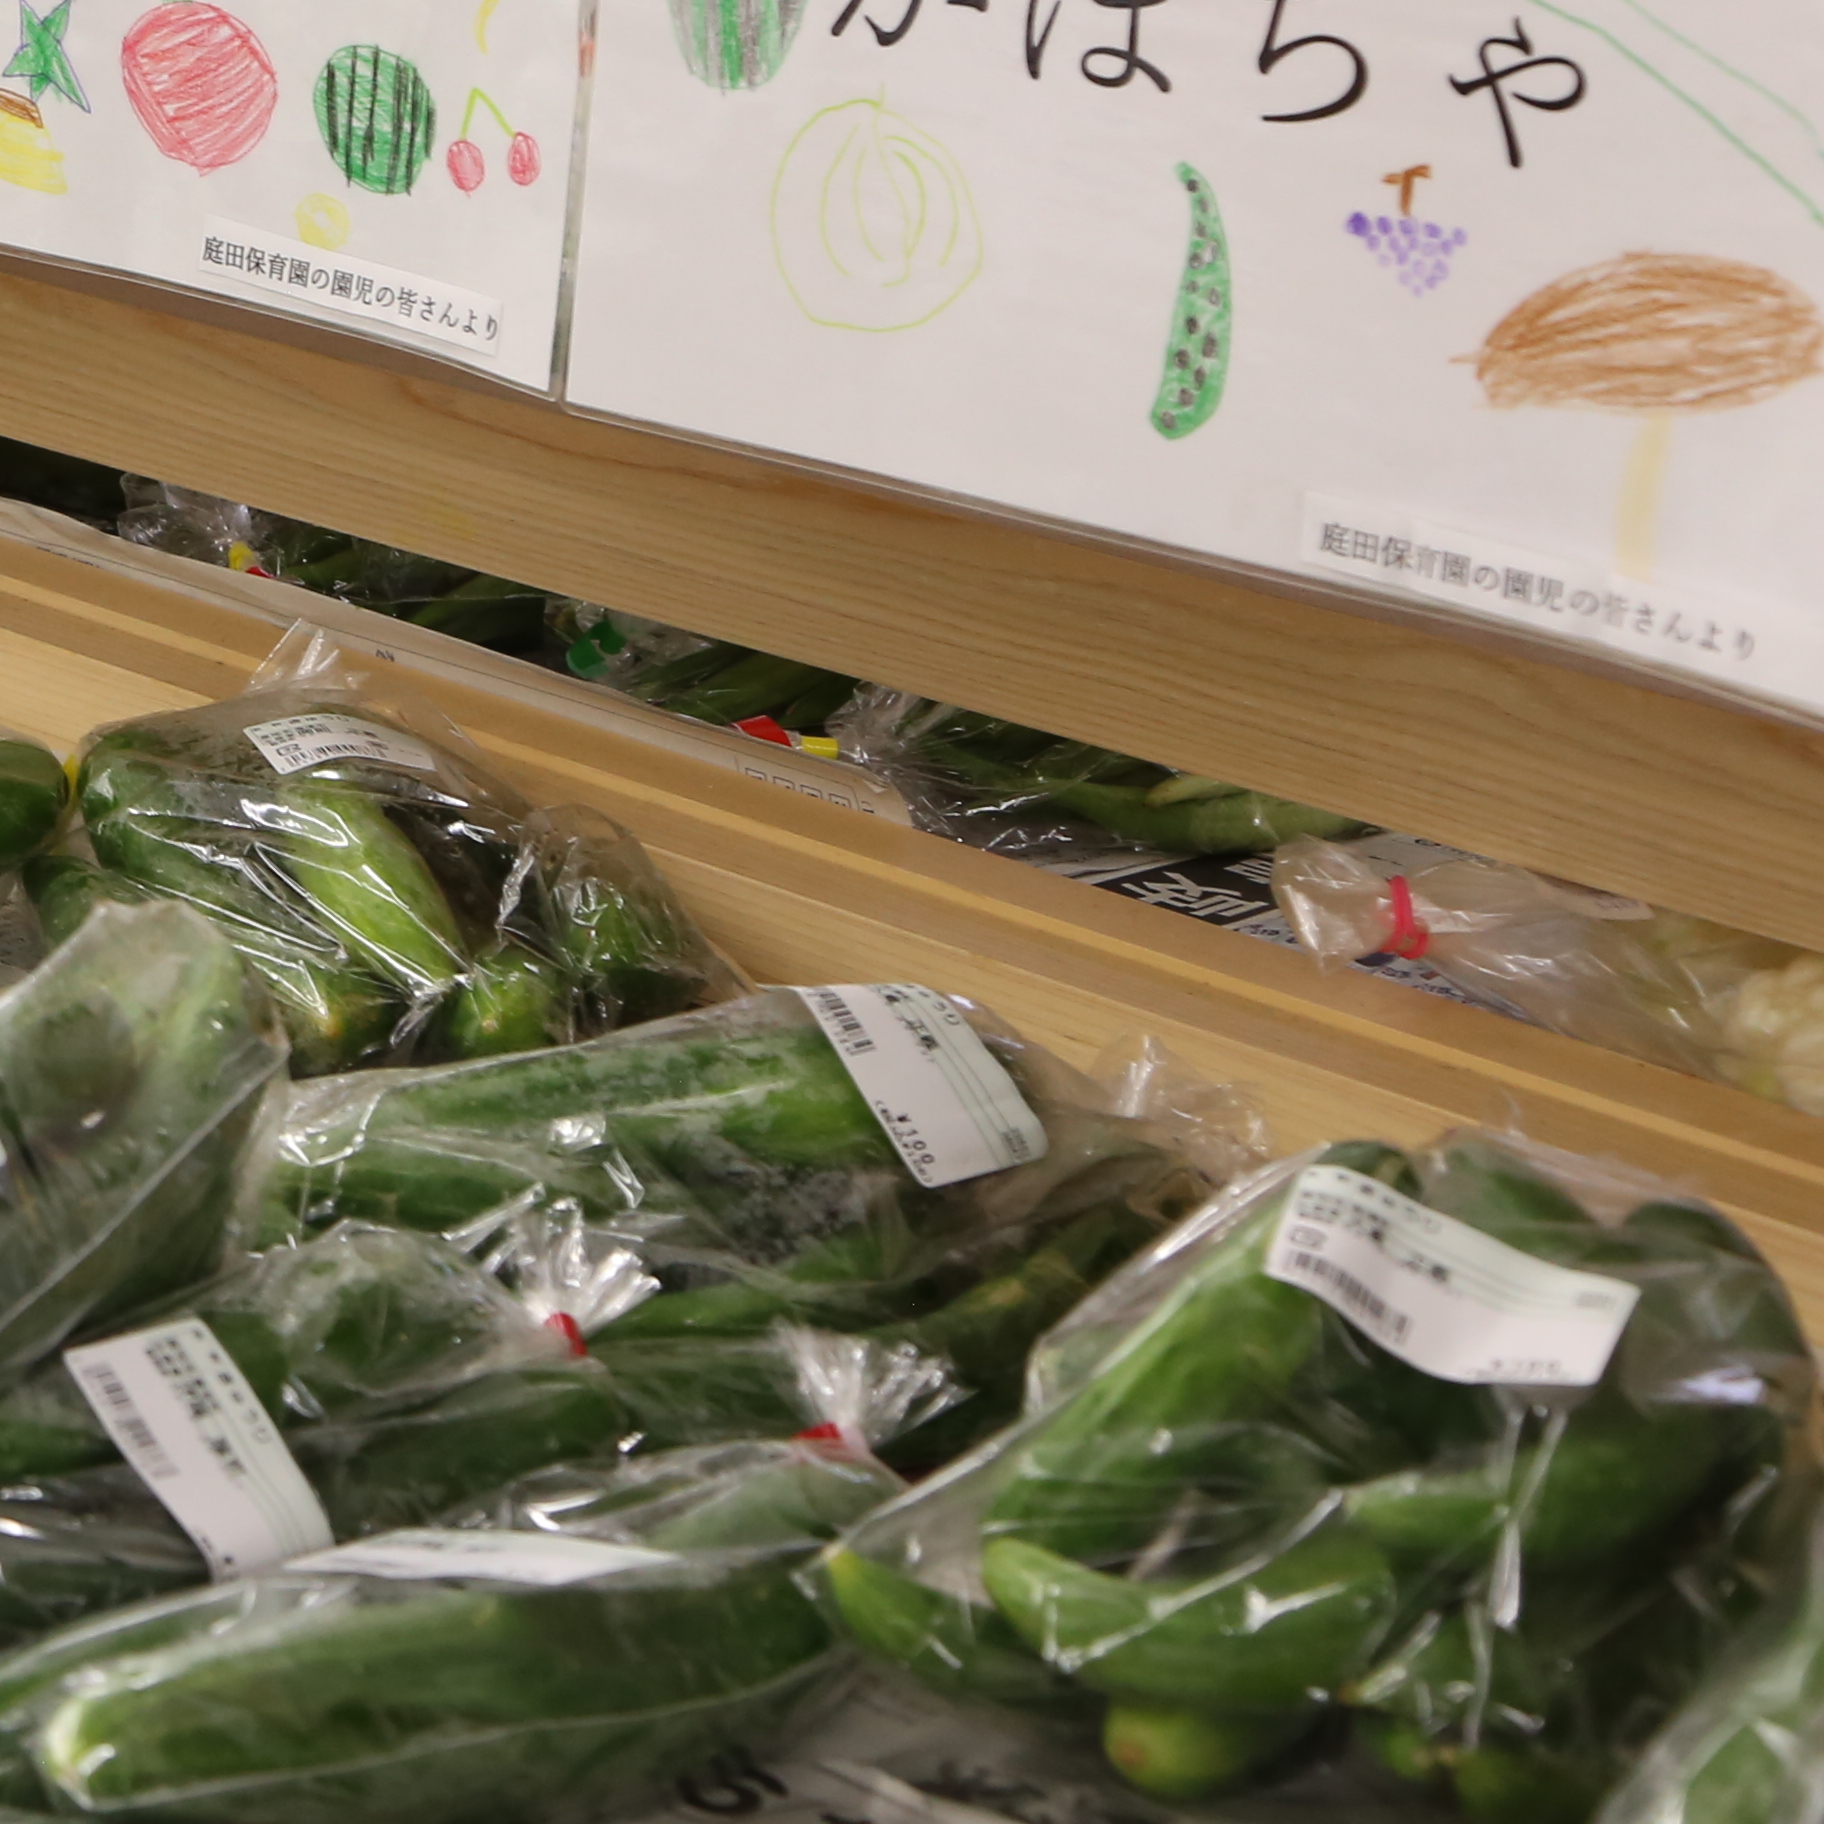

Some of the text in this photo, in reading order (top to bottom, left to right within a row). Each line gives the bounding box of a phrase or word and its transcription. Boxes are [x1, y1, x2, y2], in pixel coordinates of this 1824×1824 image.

[202, 234, 501, 343] 庭田保育園の園児の皆さんより
[1318, 520, 1757, 664] 庭田保育園の園児の皆さんより
